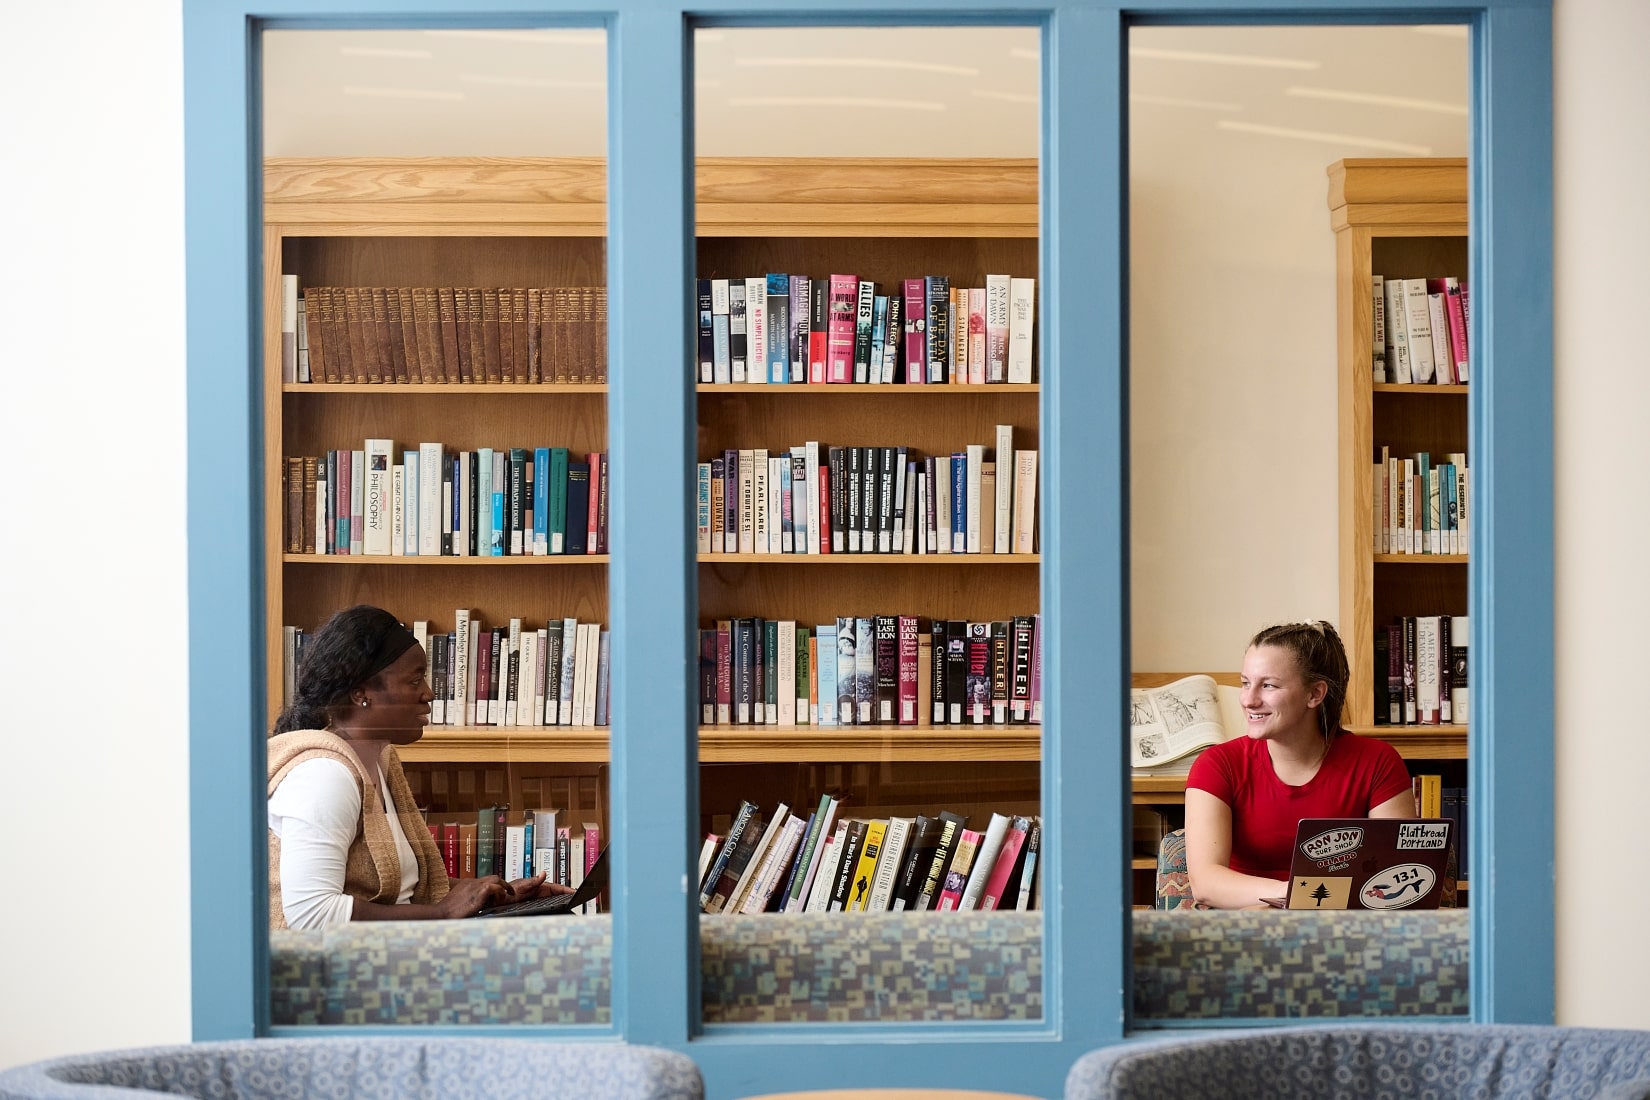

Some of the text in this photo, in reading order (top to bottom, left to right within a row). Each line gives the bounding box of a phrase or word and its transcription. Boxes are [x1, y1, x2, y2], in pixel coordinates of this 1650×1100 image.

[836, 294, 856, 302] WORLD
[860, 284, 872, 318] ALLIES
[990, 286, 996, 297] AT
[1000, 286, 1006, 298] AN
[755, 309, 762, 317] NO
[799, 280, 808, 334] ARMAGEDDON
[830, 313, 854, 322] AT ARMS
[928, 304, 938, 321] OF
[889, 300, 899, 346] JOHN KEEGA
[938, 311, 946, 363] THE DAY
[370, 473, 380, 530] PHILOSOPHY
[699, 466, 708, 526] EAGLE AGAINST THE SUN
[784, 490, 792, 522] MIDWAY
[744, 512, 750, 522] WE
[455, 620, 468, 698] Mythology for Storytellers
[972, 643, 988, 676] Hitler
[996, 642, 1004, 688] HITLER
[936, 646, 944, 699] CHARLEMAGNE
[732, 812, 752, 842] ANCIENT
[810, 822, 820, 840] PROFILE
[1400, 825, 1446, 838] flatbread
[726, 842, 737, 858] CITY
[830, 836, 842, 864] VENICE
[847, 843, 856, 859] War's
[1306, 830, 1360, 854] RON JON
[1315, 840, 1354, 856] SURF SHOP
[513, 859, 519, 868] OF
[802, 848, 812, 868] ANCIENT
[842, 860, 851, 874] Dark
[878, 822, 904, 890] THE RUSSIAN REVOLUTION
[923, 820, 956, 896] MEDVEDEV LET HISTORY JUDGE
[1316, 852, 1358, 868] ORLANDO
[836, 874, 848, 898] Shadow
[974, 868, 985, 892] WARS
[1392, 868, 1420, 884] 13.1
